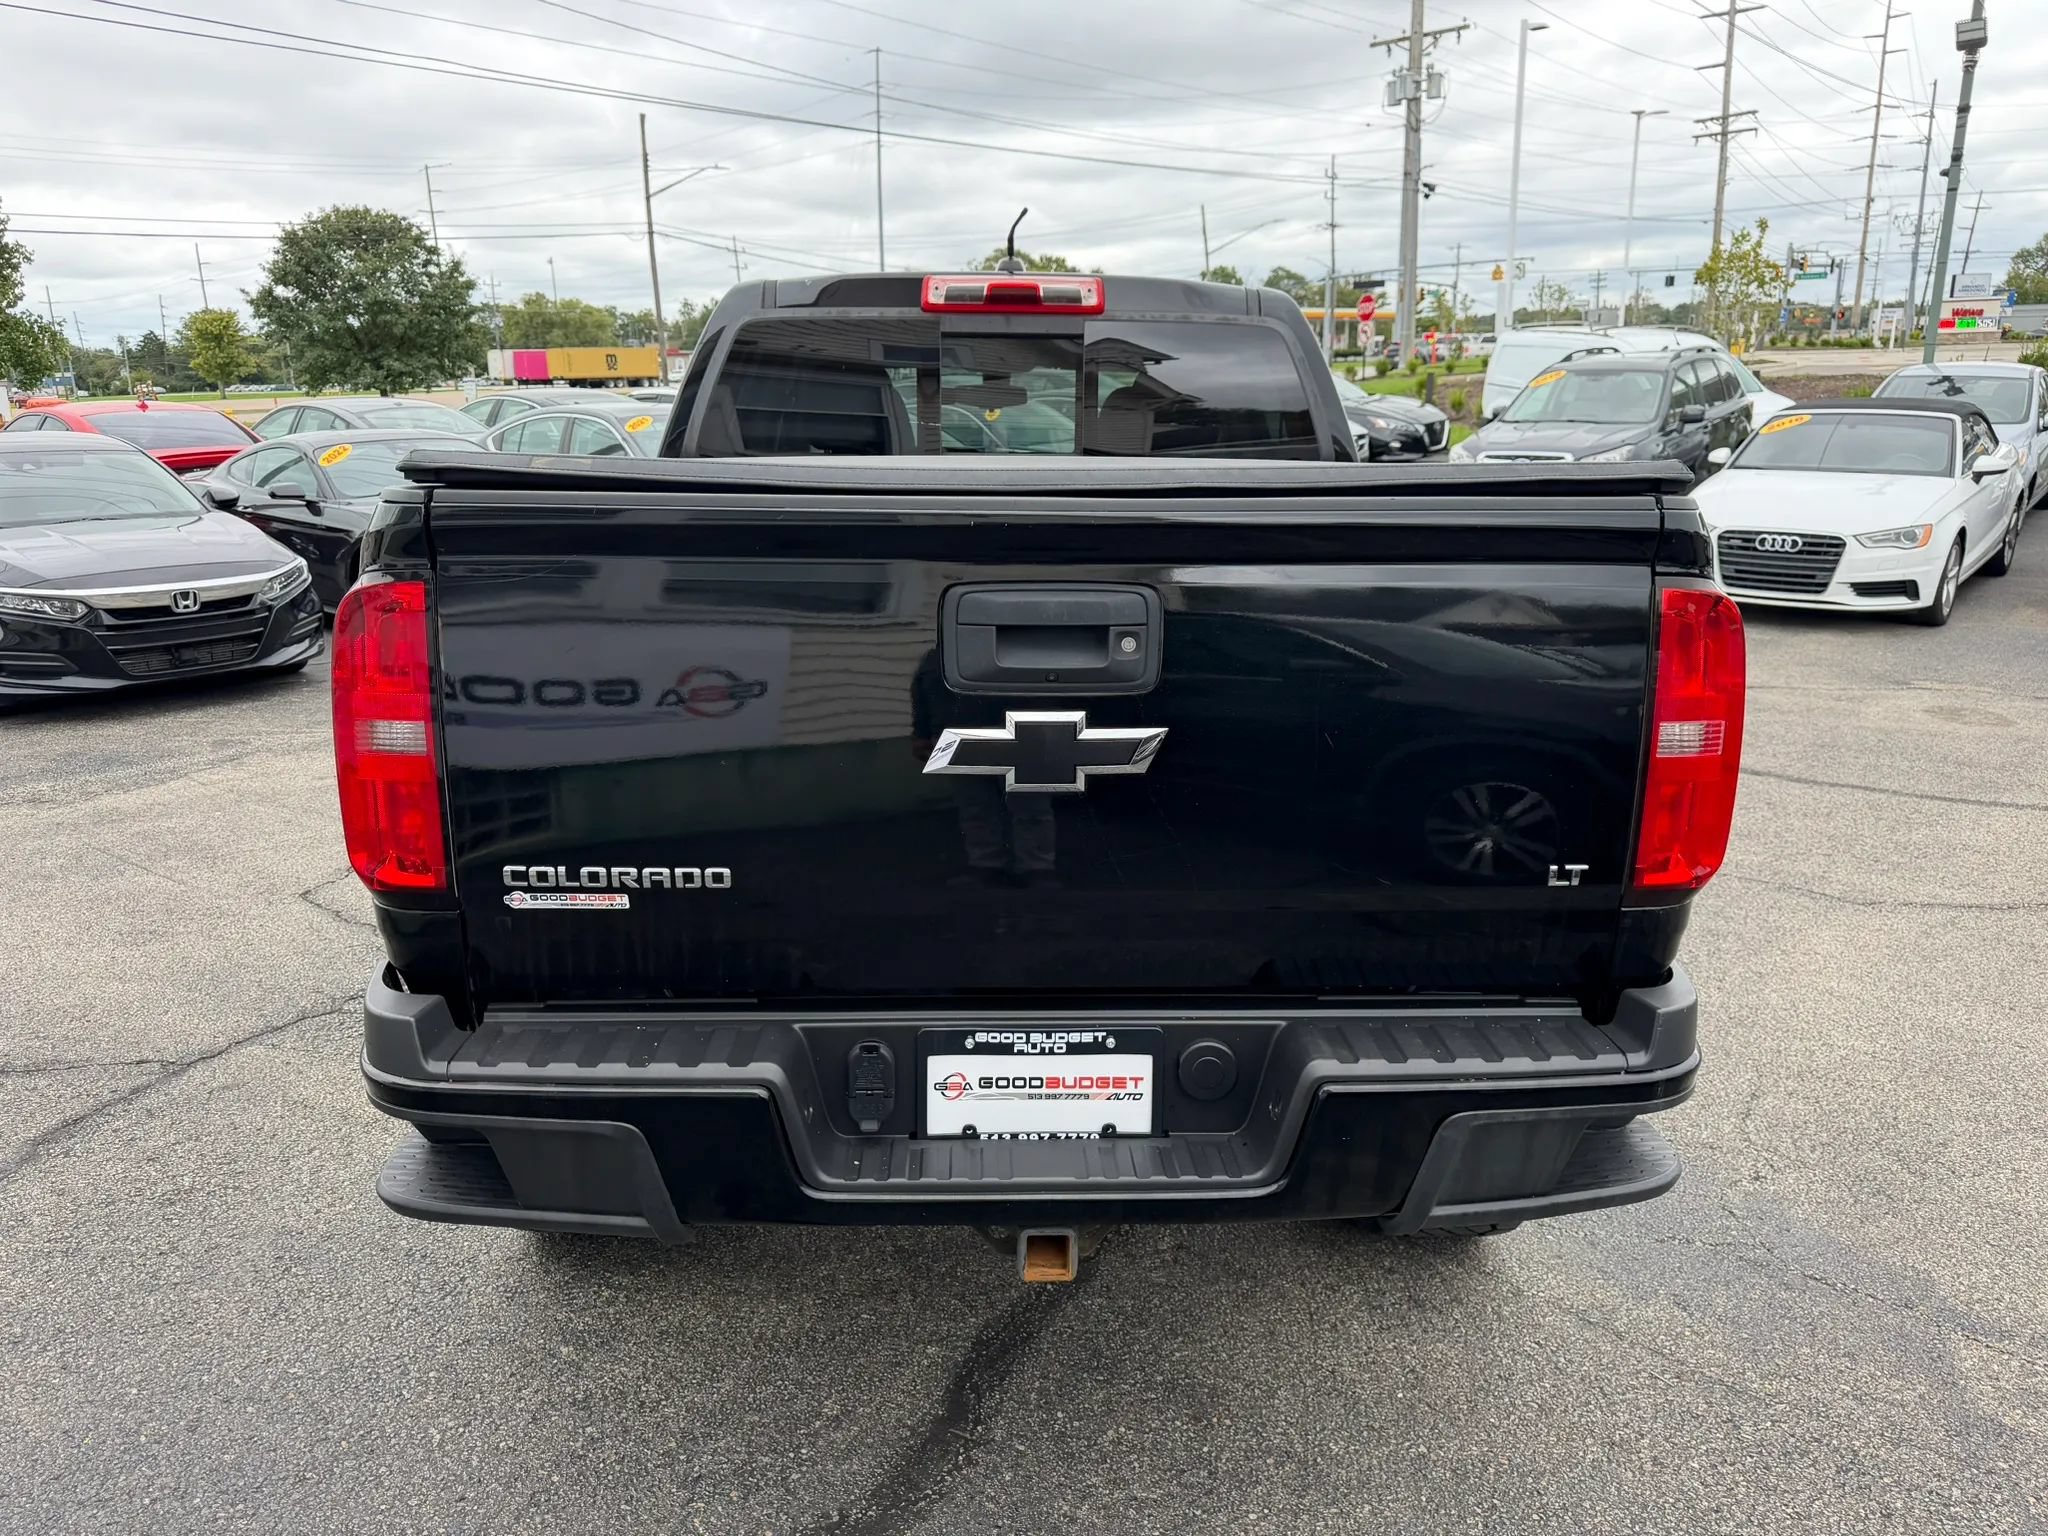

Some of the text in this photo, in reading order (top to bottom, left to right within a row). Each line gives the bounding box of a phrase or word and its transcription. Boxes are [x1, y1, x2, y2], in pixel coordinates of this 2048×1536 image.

[321, 445, 349, 465] 2022
[502, 865, 733, 889] COLORADO
[1548, 864, 1590, 887] LT
[974, 1031, 1107, 1044] GOOD BUDGET
[1013, 1043, 1067, 1054] AUTO
[1105, 1092, 1144, 1101] AUTO
